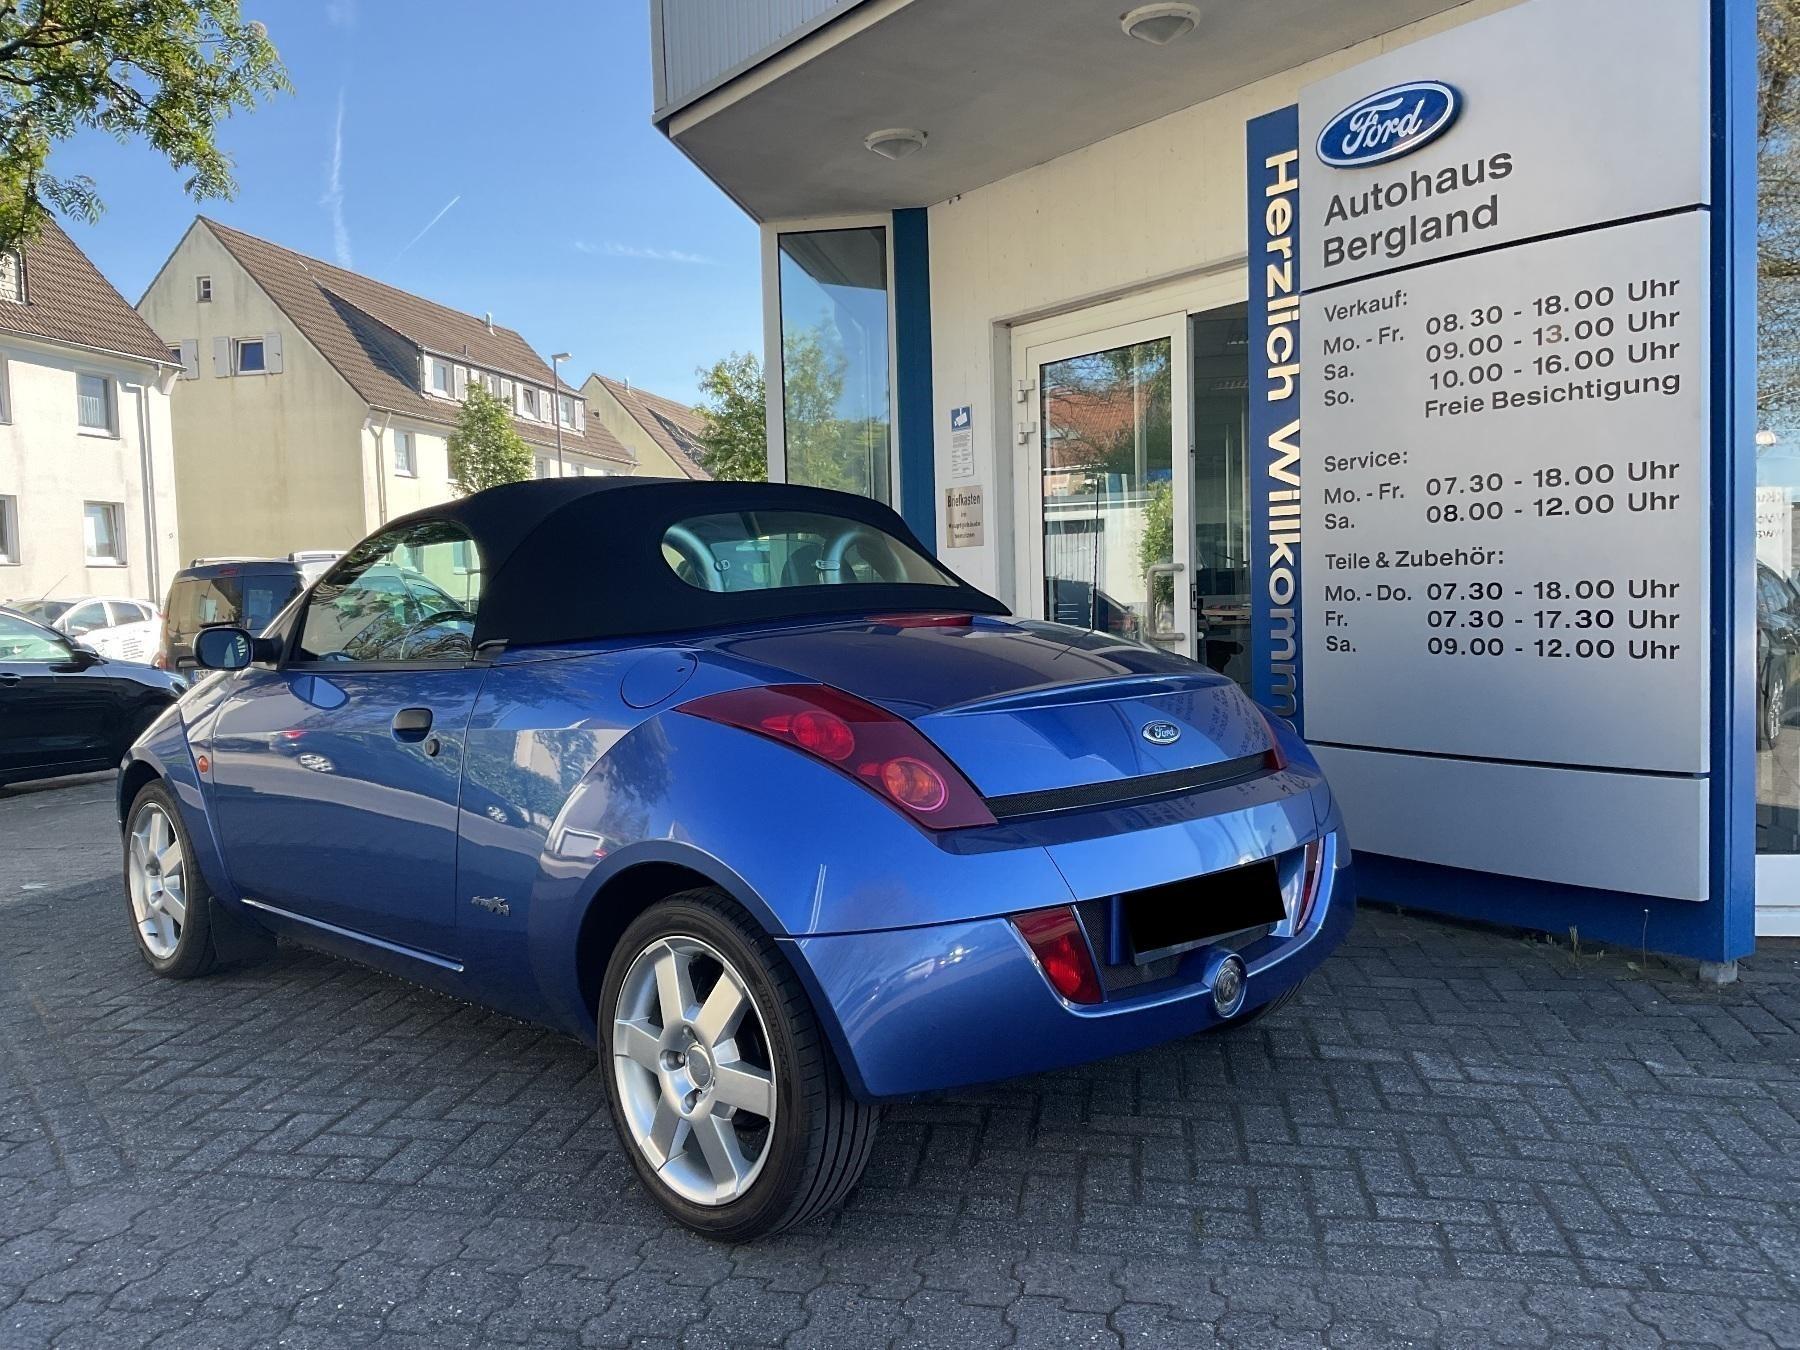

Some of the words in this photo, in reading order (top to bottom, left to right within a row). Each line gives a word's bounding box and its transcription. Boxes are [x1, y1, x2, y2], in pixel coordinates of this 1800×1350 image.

[1342, 97, 1425, 155] Ford
[1324, 153, 1512, 226] Autohaus
[1324, 194, 1497, 268] Bergland
[1265, 149, 1299, 402] Herzlich
[1324, 290, 1407, 322] Verkauf:
[1426, 306, 1502, 335] 08.30
[1533, 287, 1613, 316] 18.00
[1628, 279, 1680, 301] Uhr
[1324, 364, 1354, 381] Sa.
[1426, 335, 1502, 363] 09.00
[1533, 317, 1614, 346] 13.00
[1628, 311, 1680, 332] Uhr
[1324, 390, 1354, 406] So.
[1430, 363, 1502, 390] 10.00
[1533, 348, 1614, 375] 16.00
[1628, 342, 1680, 363] Uhr
[1426, 396, 1484, 418] Freie
[1492, 374, 1679, 409] Besichtigung
[1325, 451, 1407, 472] Service:
[1426, 473, 1503, 496] 07.30
[1533, 464, 1614, 487] 18.00
[1628, 461, 1679, 481] Uhr
[948, 494, 980, 507] Briefkasten
[1325, 513, 1354, 529] Sa.
[1427, 502, 1503, 523] 08.00
[1533, 494, 1614, 517] 12.00
[1628, 492, 1679, 512] Uhr
[1268, 418, 1299, 733] Willkomm
[1325, 553, 1370, 569] Teile
[1376, 552, 1389, 568] &
[1395, 547, 1503, 567] Zubehör:
[1427, 582, 1502, 600] 07.30
[1534, 580, 1614, 599] 18.00
[1629, 579, 1680, 598] Uhr
[1326, 611, 1348, 626] Fr.
[1428, 610, 1503, 628] 07.30
[1534, 610, 1614, 628] 17.30
[1629, 610, 1680, 629] Uhr
[1327, 636, 1356, 652] Sa.
[1428, 637, 1503, 656] 09.00
[1534, 639, 1614, 658] 12.00
[1629, 640, 1680, 659] Uhr
